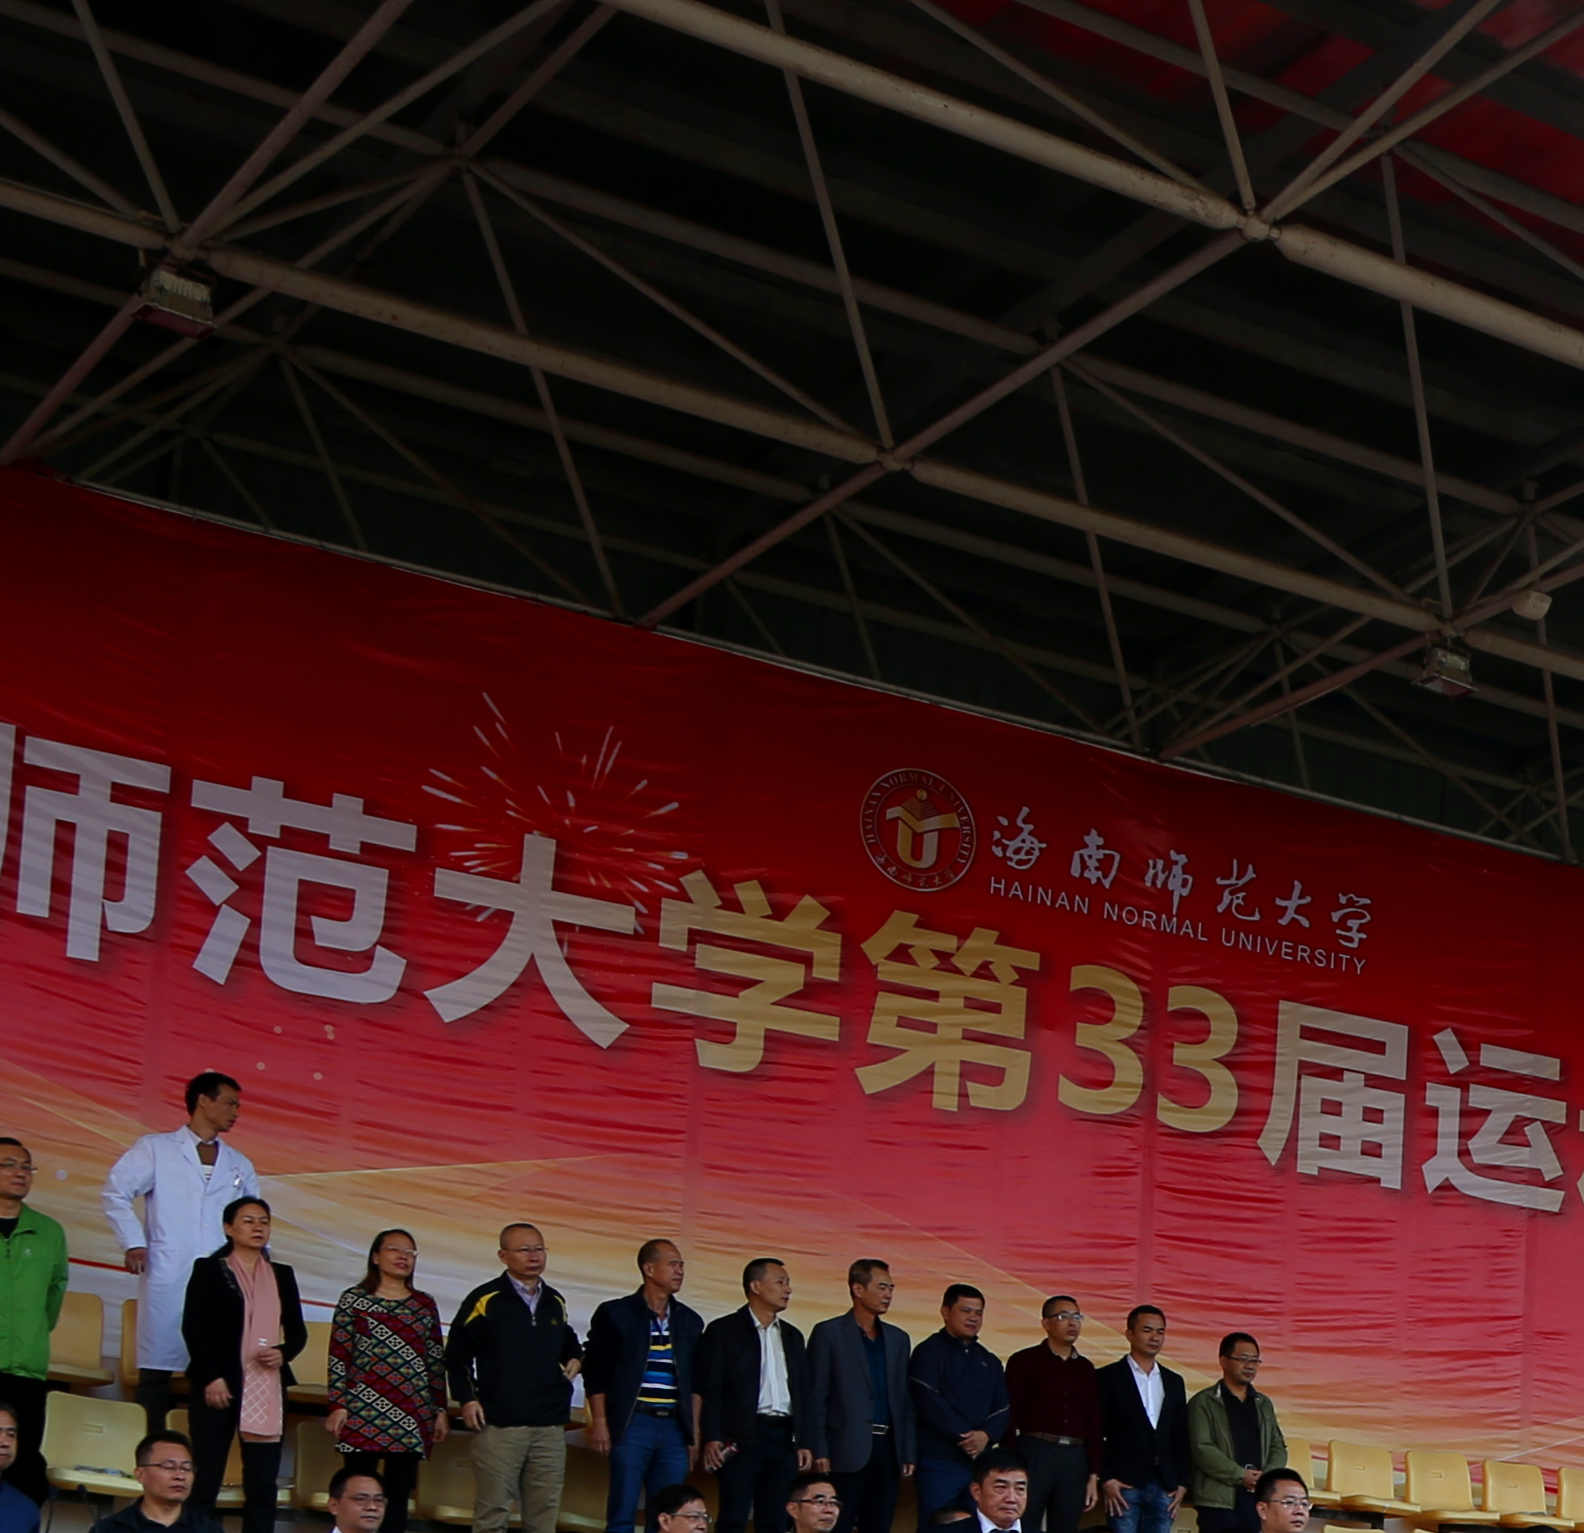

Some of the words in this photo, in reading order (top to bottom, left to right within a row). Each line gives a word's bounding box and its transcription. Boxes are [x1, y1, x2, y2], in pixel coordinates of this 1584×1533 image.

[989, 876, 1090, 915] HAINAN
[1103, 902, 1209, 942] NORMAL
[1221, 927, 1367, 976] UNIVERSITY
[991, 806, 1372, 948] 海南师范大学
